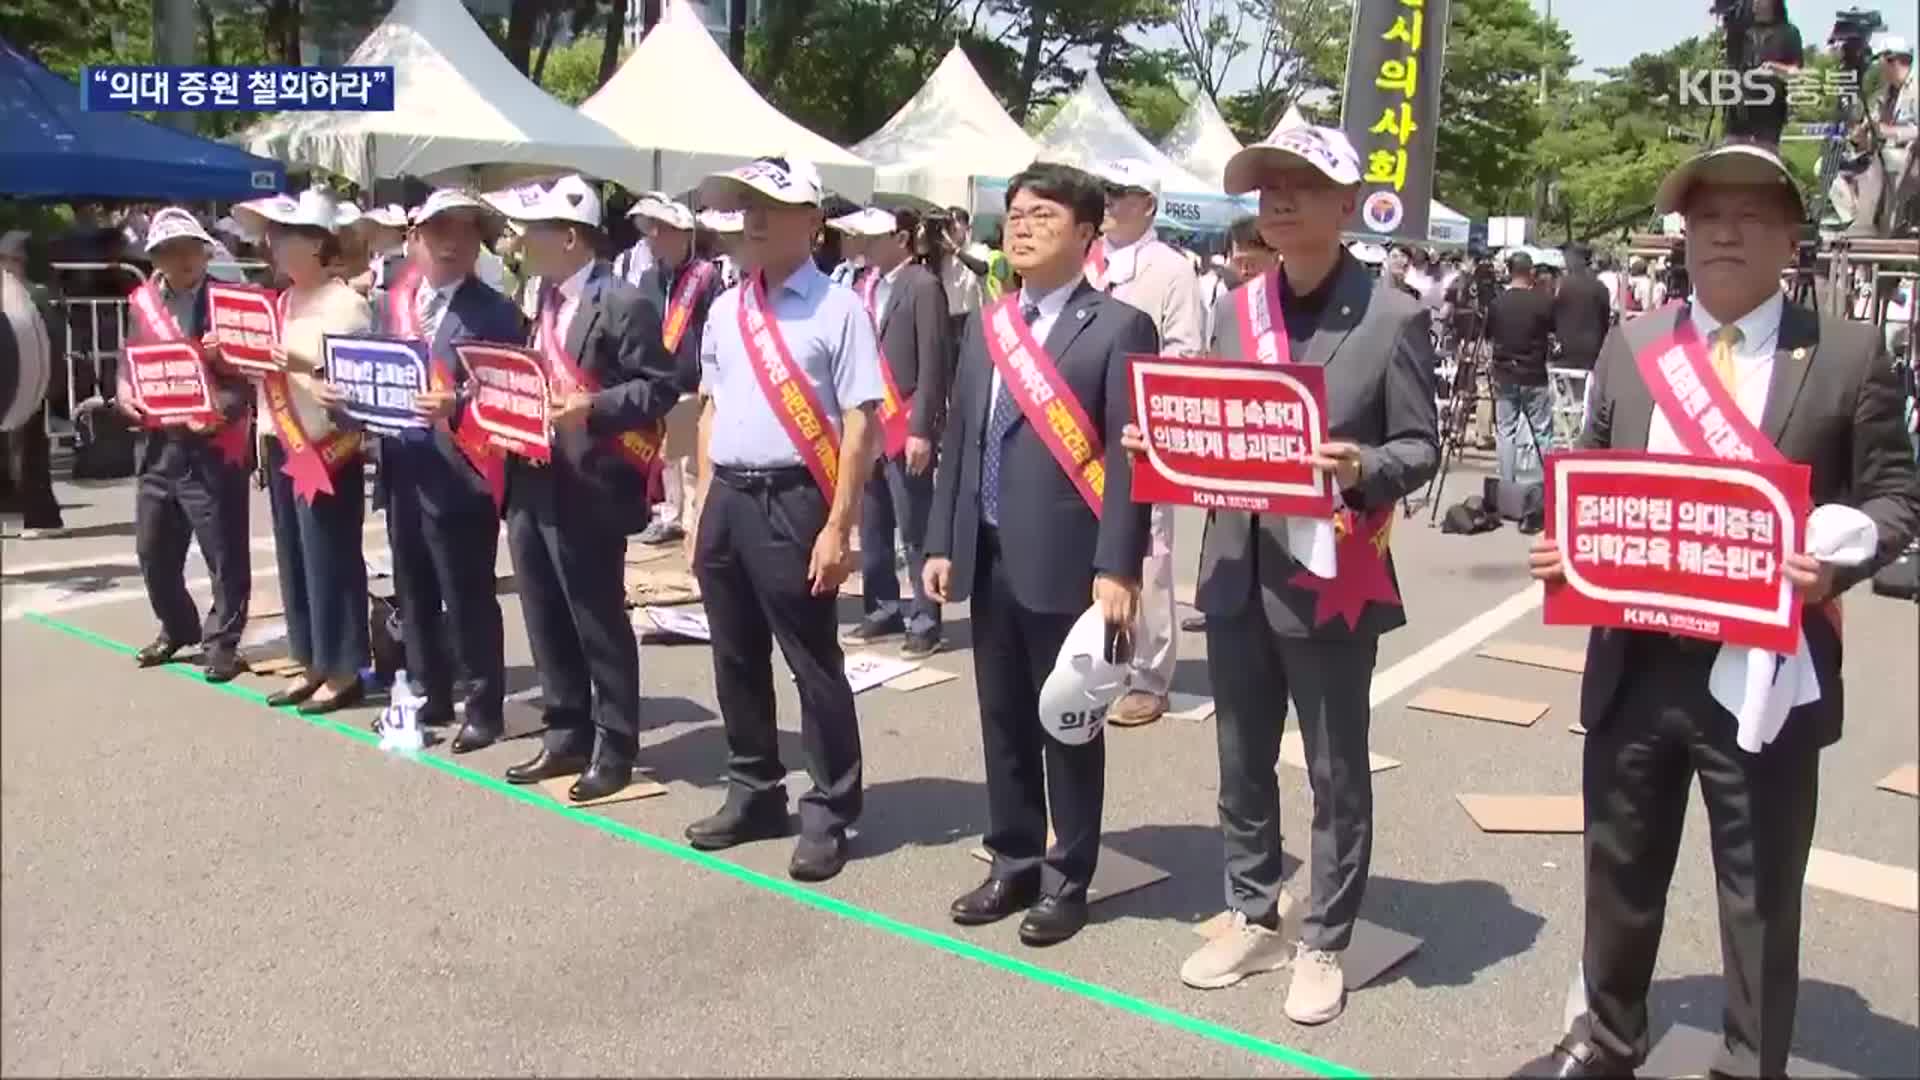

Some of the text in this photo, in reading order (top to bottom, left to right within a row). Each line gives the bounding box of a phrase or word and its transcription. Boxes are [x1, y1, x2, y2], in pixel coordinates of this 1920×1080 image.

[1363, 0, 1424, 192] 시의사회
[1165, 201, 1201, 220] PRESS
[1150, 394, 1221, 427] 의대정원
[1154, 425, 1225, 459] 의료체계
[1575, 495, 1776, 545] 준비안된 의대증원
[1574, 533, 1777, 585] 의학교육 훼손된다
